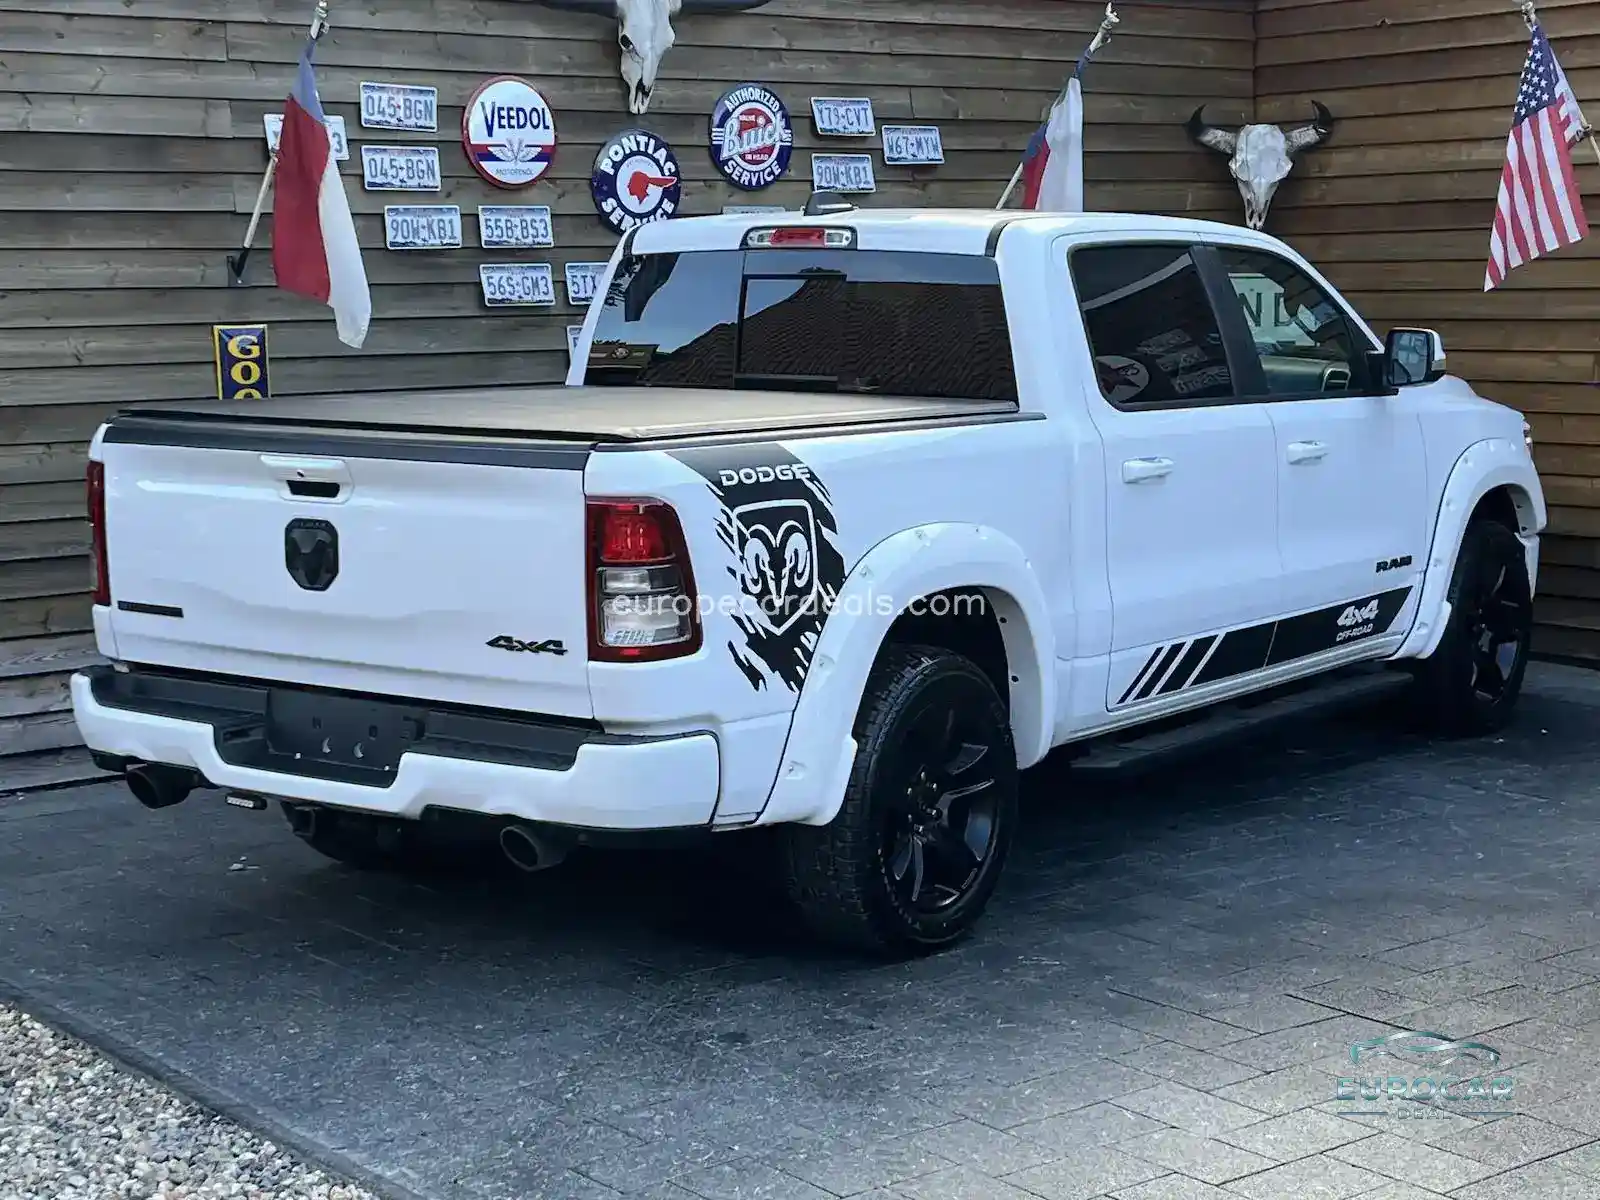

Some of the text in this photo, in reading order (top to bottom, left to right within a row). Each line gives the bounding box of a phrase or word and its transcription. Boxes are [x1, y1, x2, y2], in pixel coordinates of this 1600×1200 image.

[724, 87, 780, 113] AUTHORIZED
[480, 101, 550, 138] VEEDOL
[720, 110, 791, 161] Buick
[600, 135, 676, 176] PONTIAC
[724, 160, 781, 186] SERVICE
[718, 463, 811, 487] DODGE
[1375, 554, 1413, 574] RAM
[1336, 599, 1379, 627] 4x4
[485, 635, 569, 656] 4x4
[1336, 623, 1374, 642] OFF-ROAD
